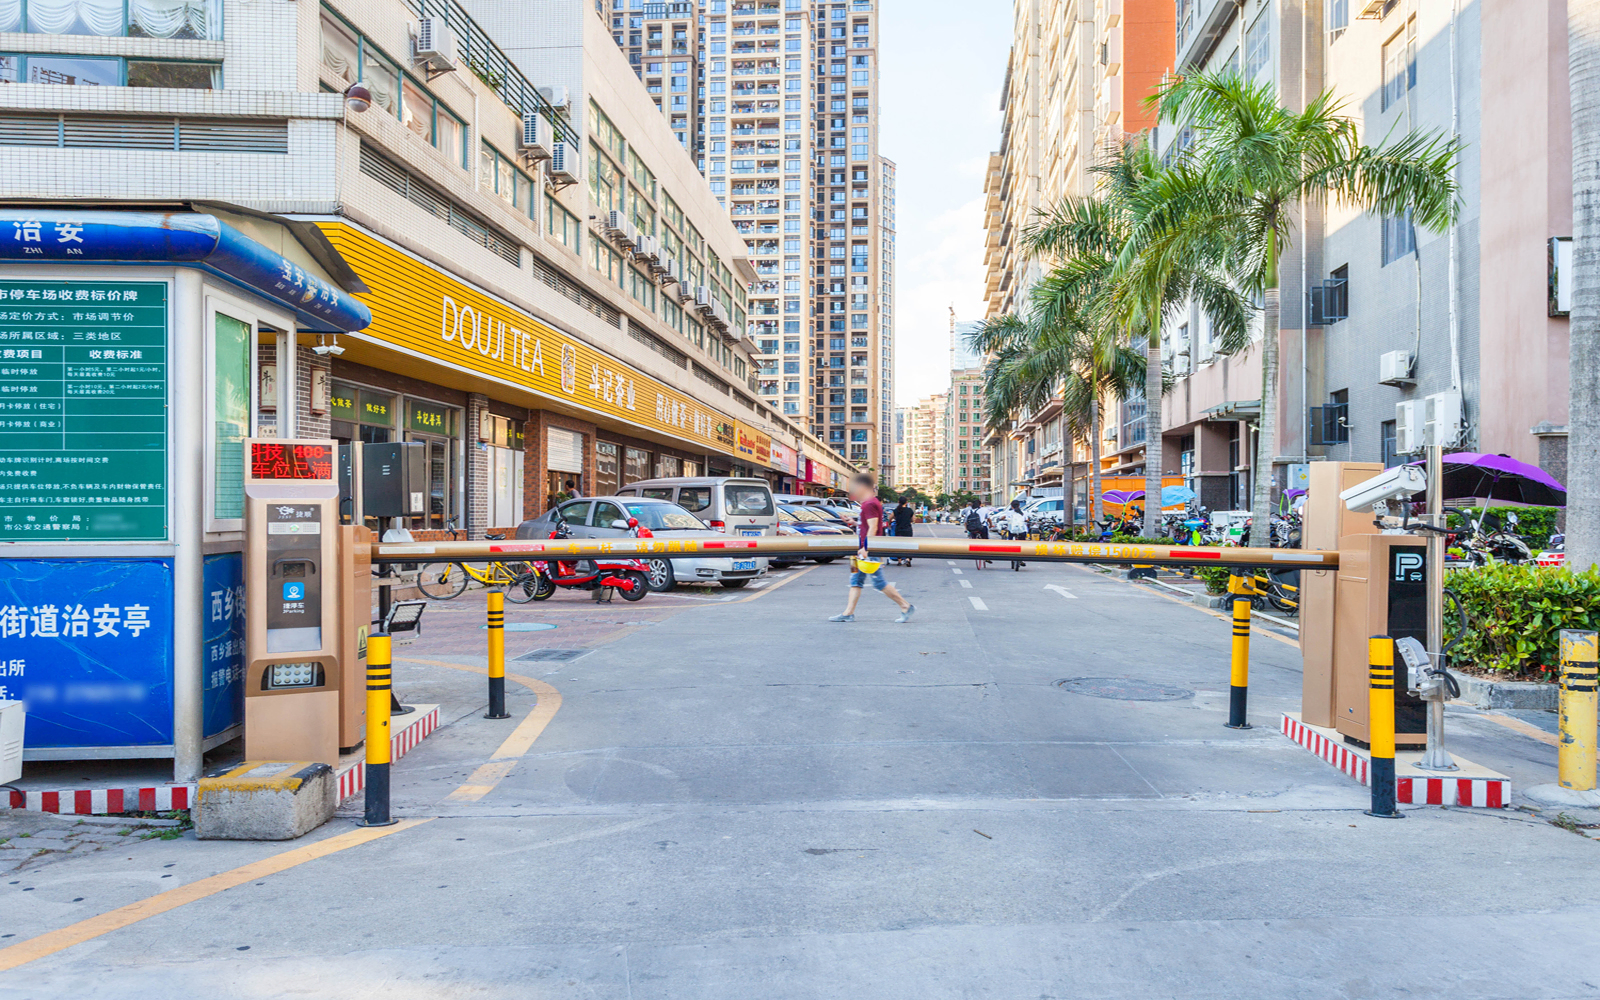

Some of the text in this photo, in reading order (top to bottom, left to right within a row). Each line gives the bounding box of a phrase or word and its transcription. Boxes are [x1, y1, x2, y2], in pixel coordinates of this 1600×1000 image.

[13, 217, 84, 243] 治安
[442, 295, 505, 362] DOUJI
[510, 327, 544, 376] TEA
[0, 349, 143, 359] 费项目 收费标准
[636, 540, 698, 553] 请勿跟随
[0, 604, 150, 638] 街道治安亭
